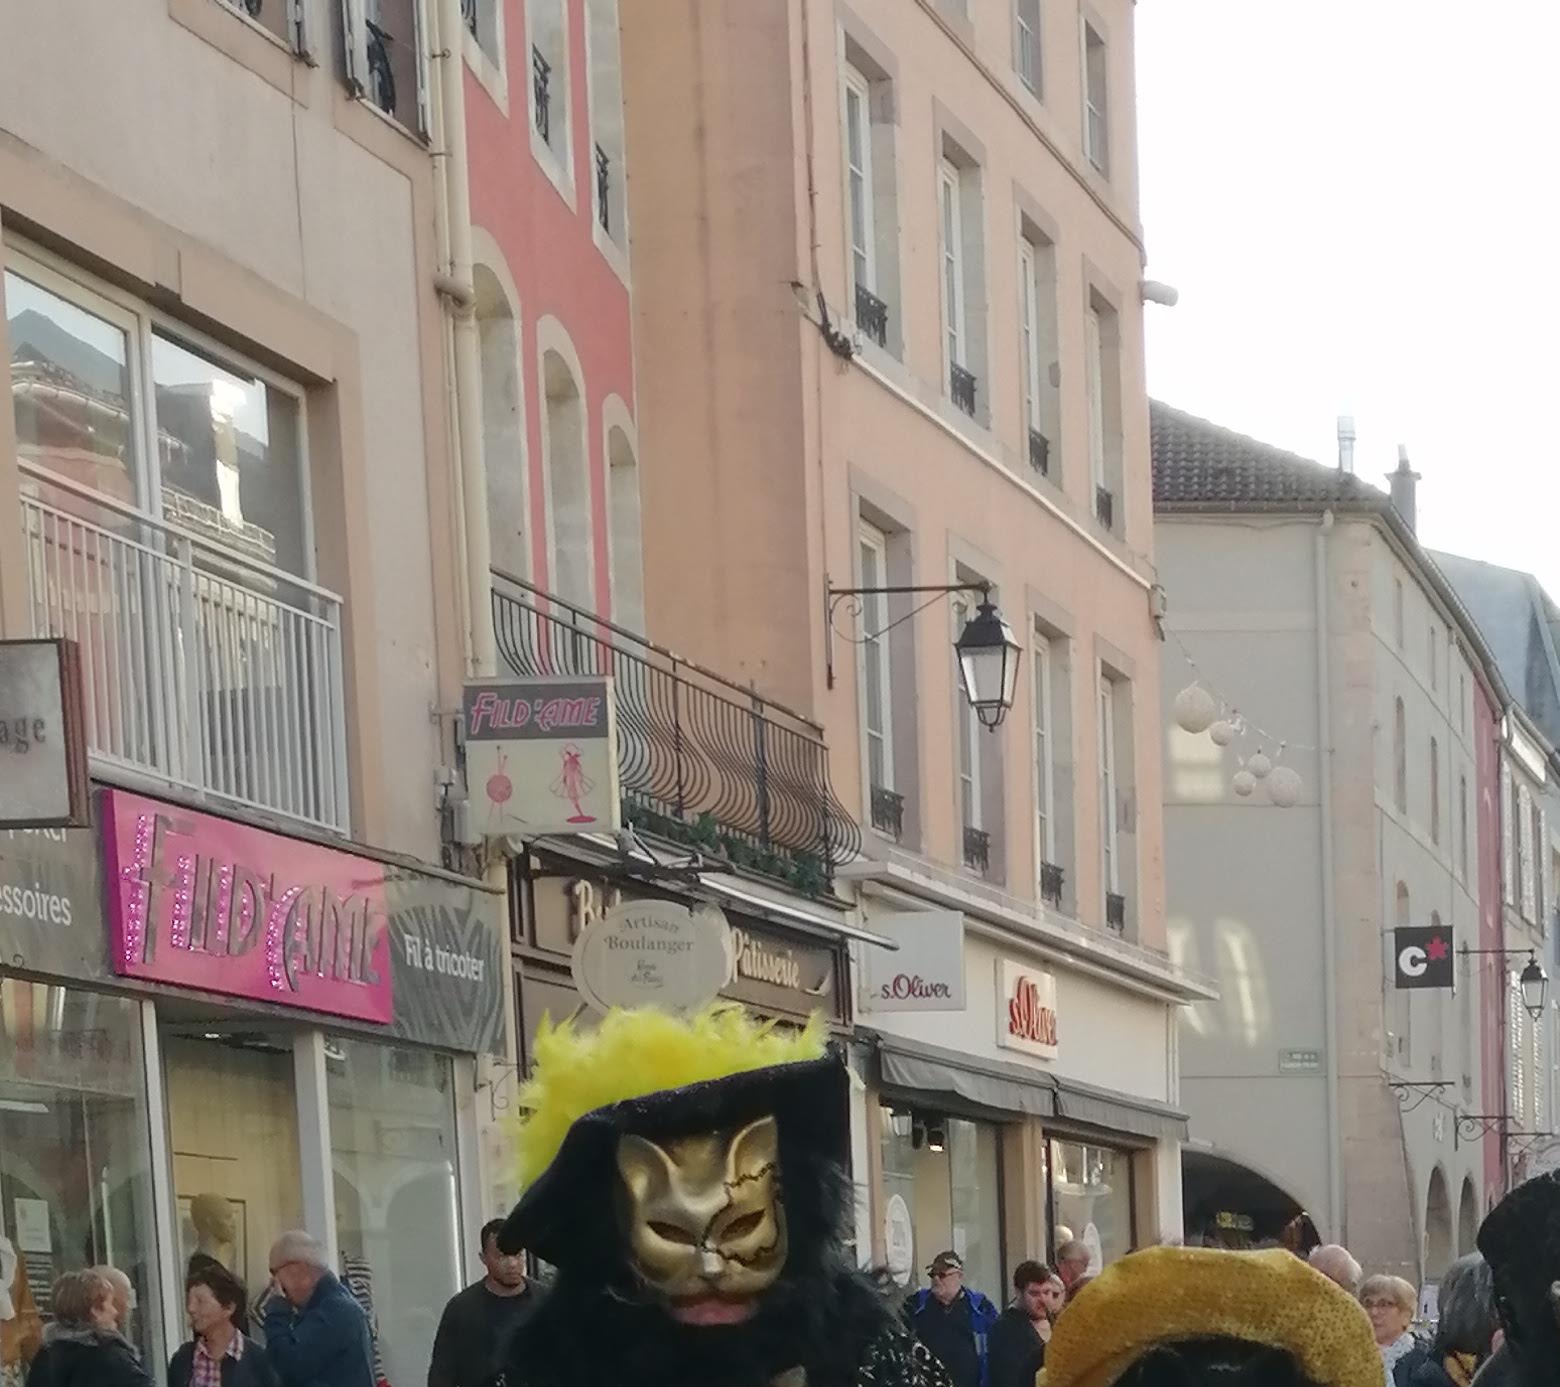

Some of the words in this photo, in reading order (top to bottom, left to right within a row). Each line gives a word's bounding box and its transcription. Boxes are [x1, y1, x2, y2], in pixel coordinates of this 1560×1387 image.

[0, 882, 72, 926] ssoires
[620, 916, 679, 934] Artisan
[404, 934, 423, 969] Fil
[424, 938, 434, 972] à
[435, 944, 484, 982] tricoter
[603, 936, 694, 955] Boulanger
[881, 974, 951, 1000] s.Oliver
